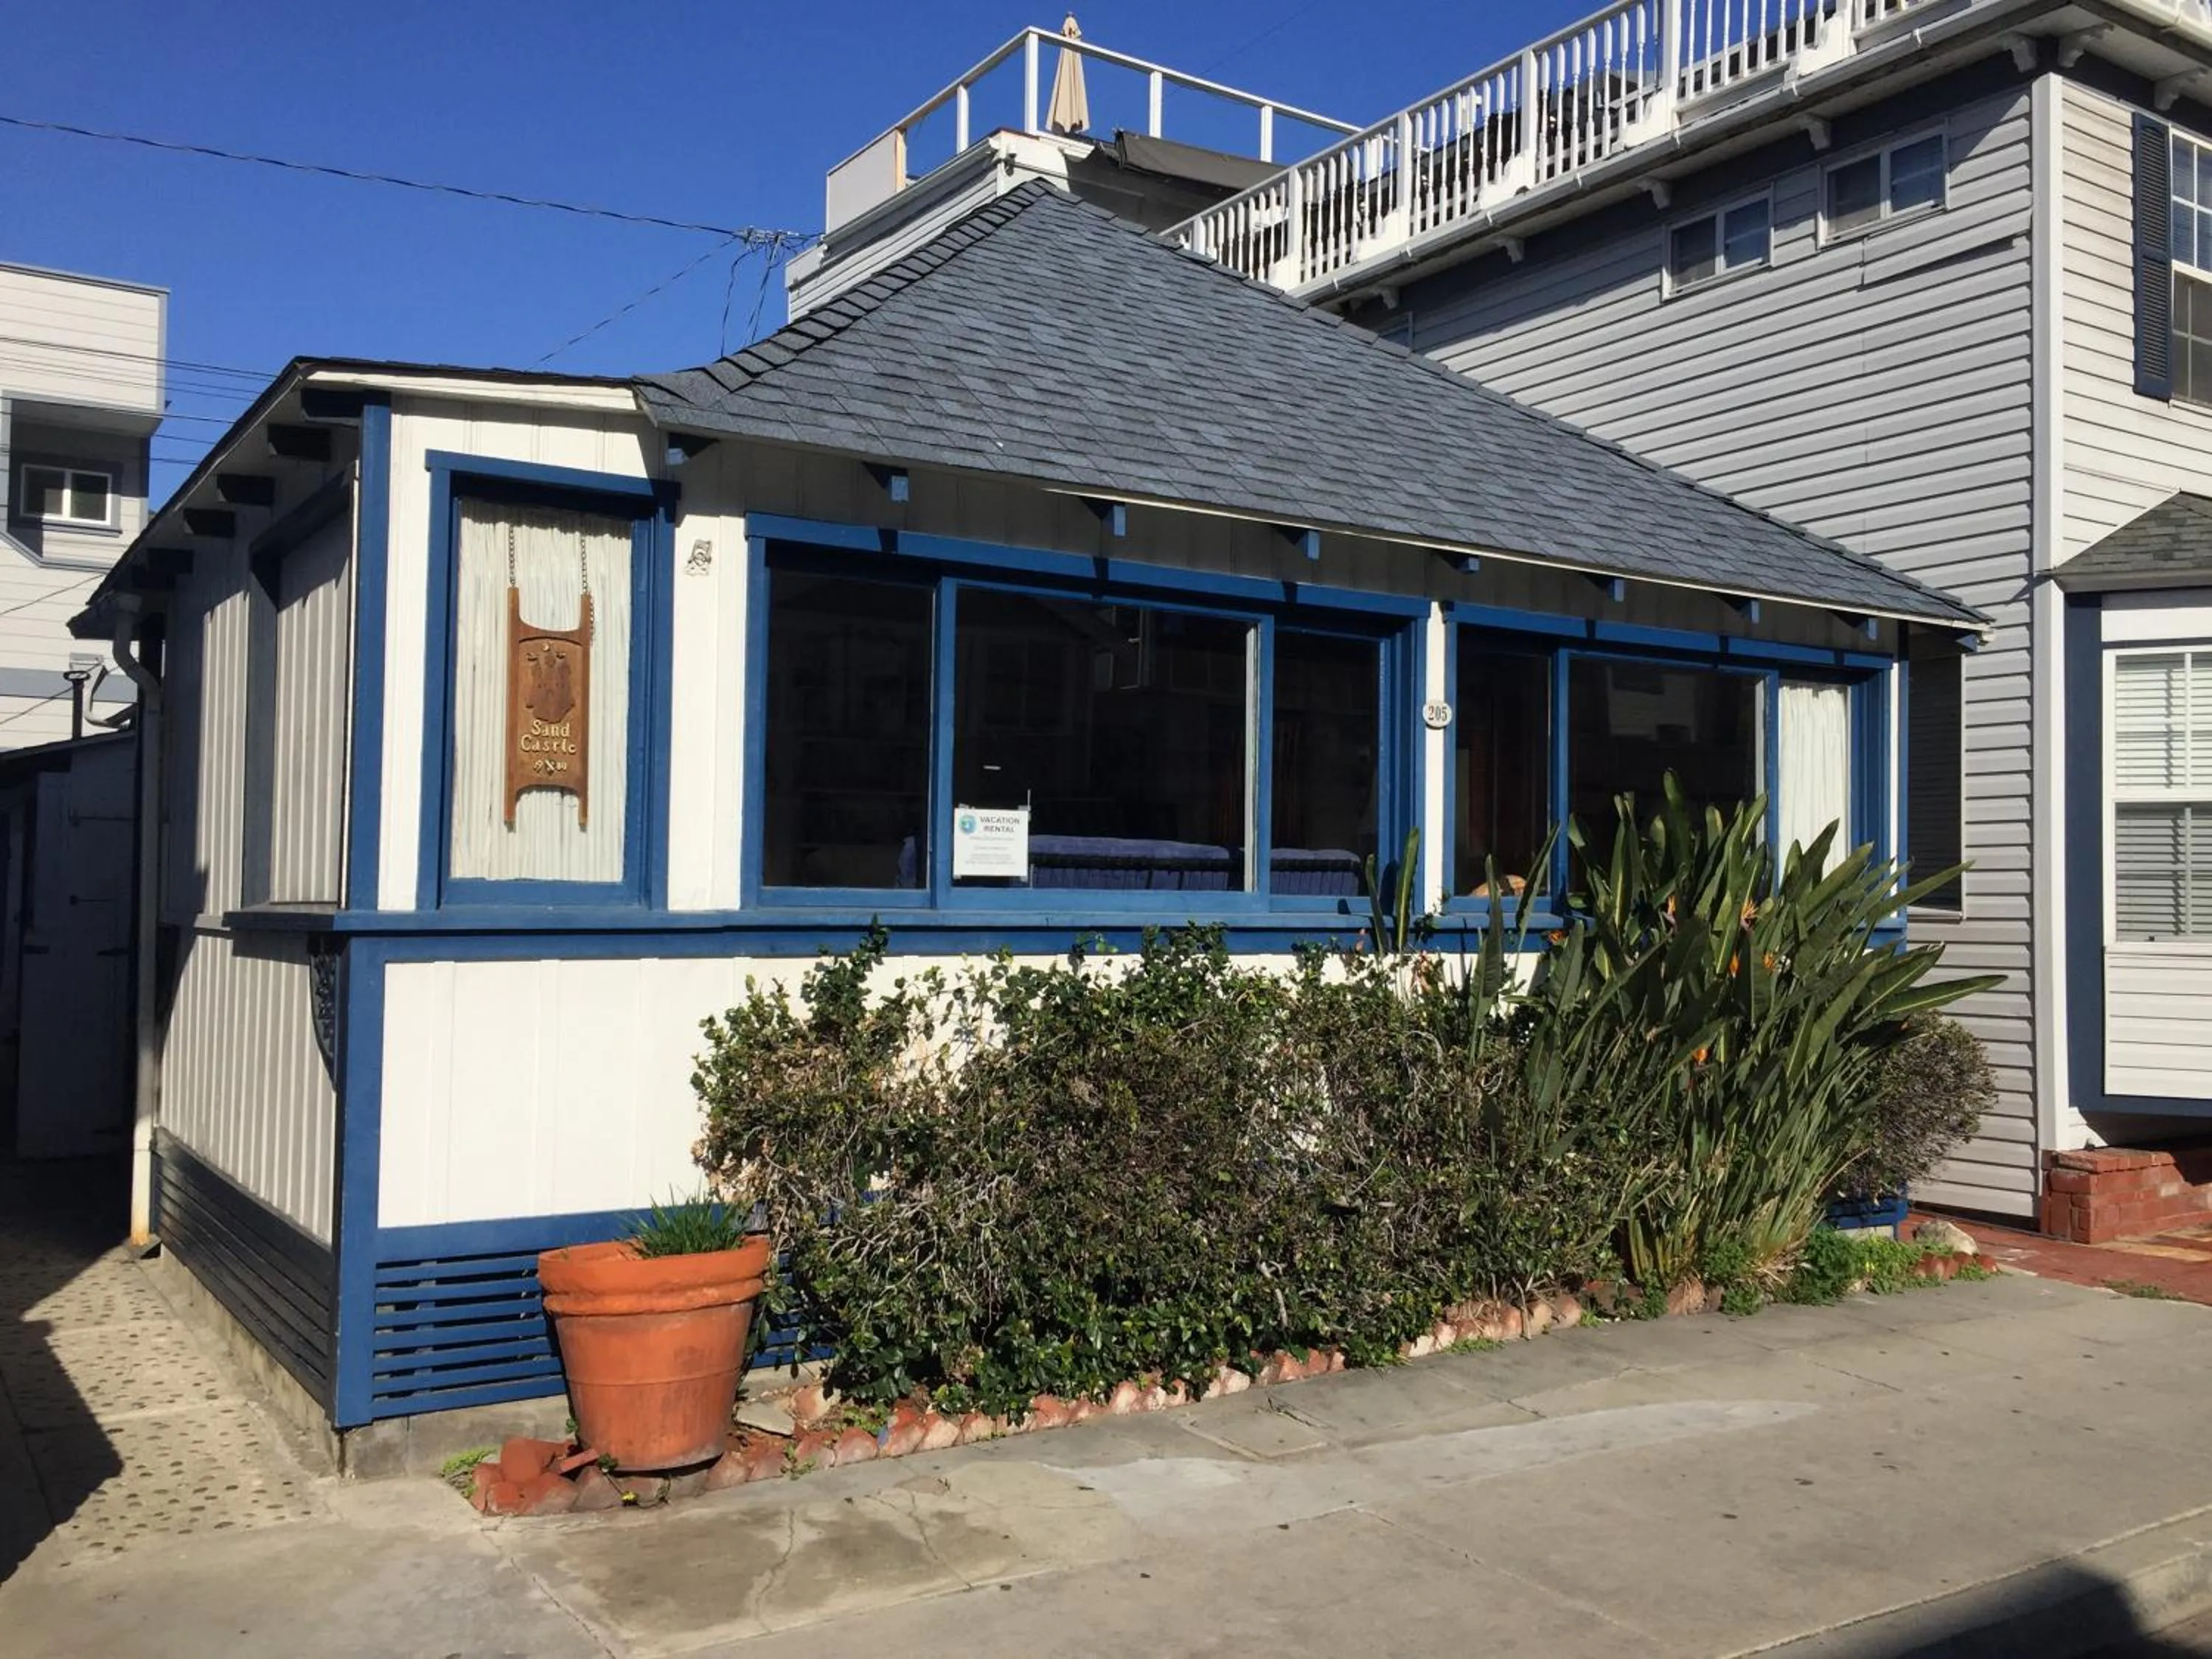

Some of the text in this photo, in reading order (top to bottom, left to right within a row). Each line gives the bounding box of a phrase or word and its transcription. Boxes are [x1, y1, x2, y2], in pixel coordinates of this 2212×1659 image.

[1428, 705, 1447, 722] 205
[531, 719, 571, 737] Sand
[521, 734, 577, 754] Castle
[979, 815, 1020, 824] VACATION
